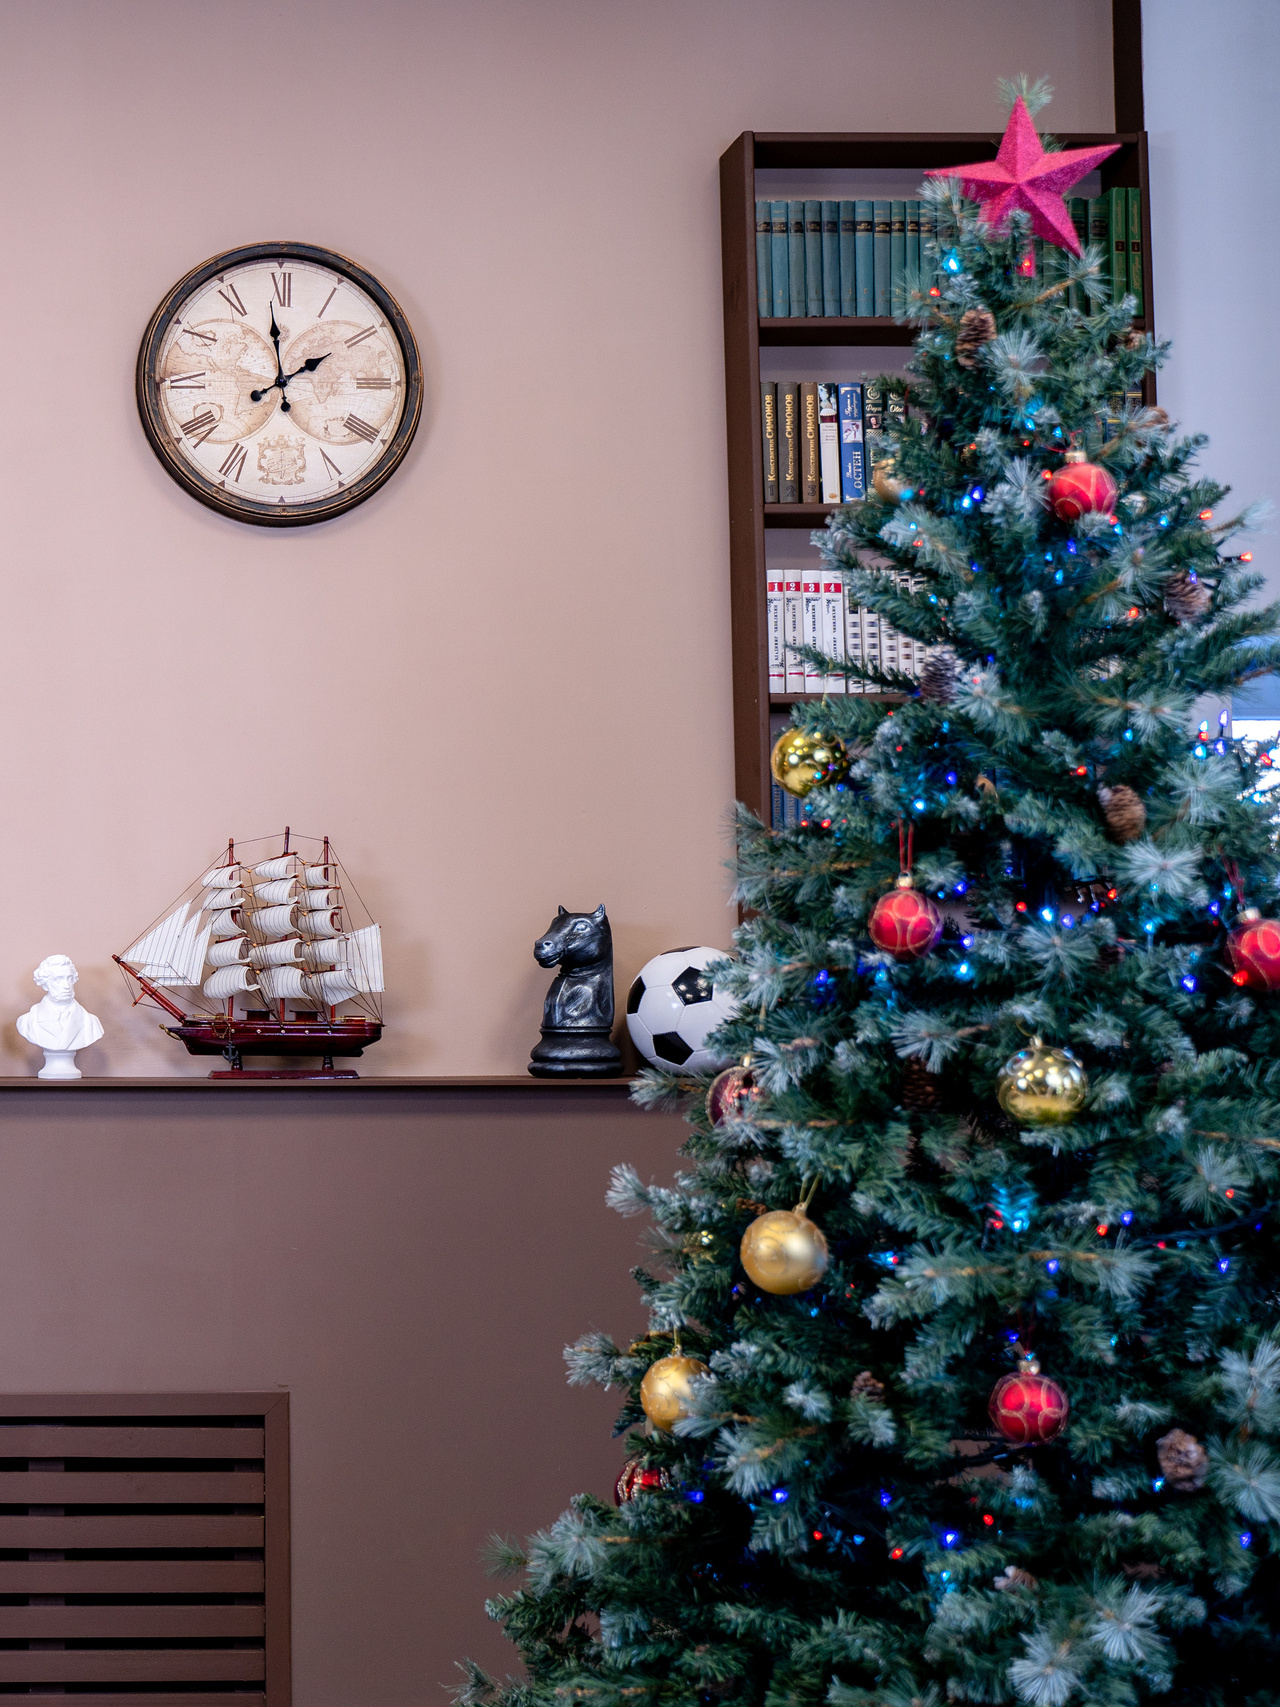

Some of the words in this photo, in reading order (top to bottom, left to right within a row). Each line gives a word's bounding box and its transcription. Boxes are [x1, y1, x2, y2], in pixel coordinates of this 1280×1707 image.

[270, 272, 293, 307] XII
[356, 377, 392, 389] III
[765, 394, 774, 439] СИМОНОВ
[785, 394, 794, 438] СИМОНОВ
[806, 394, 815, 439] СИМОНОВ
[852, 451, 863, 489] ОСТЕН
[785, 485, 795, 497] 2
[807, 485, 816, 496] 3
[829, 584, 835, 592] 4
